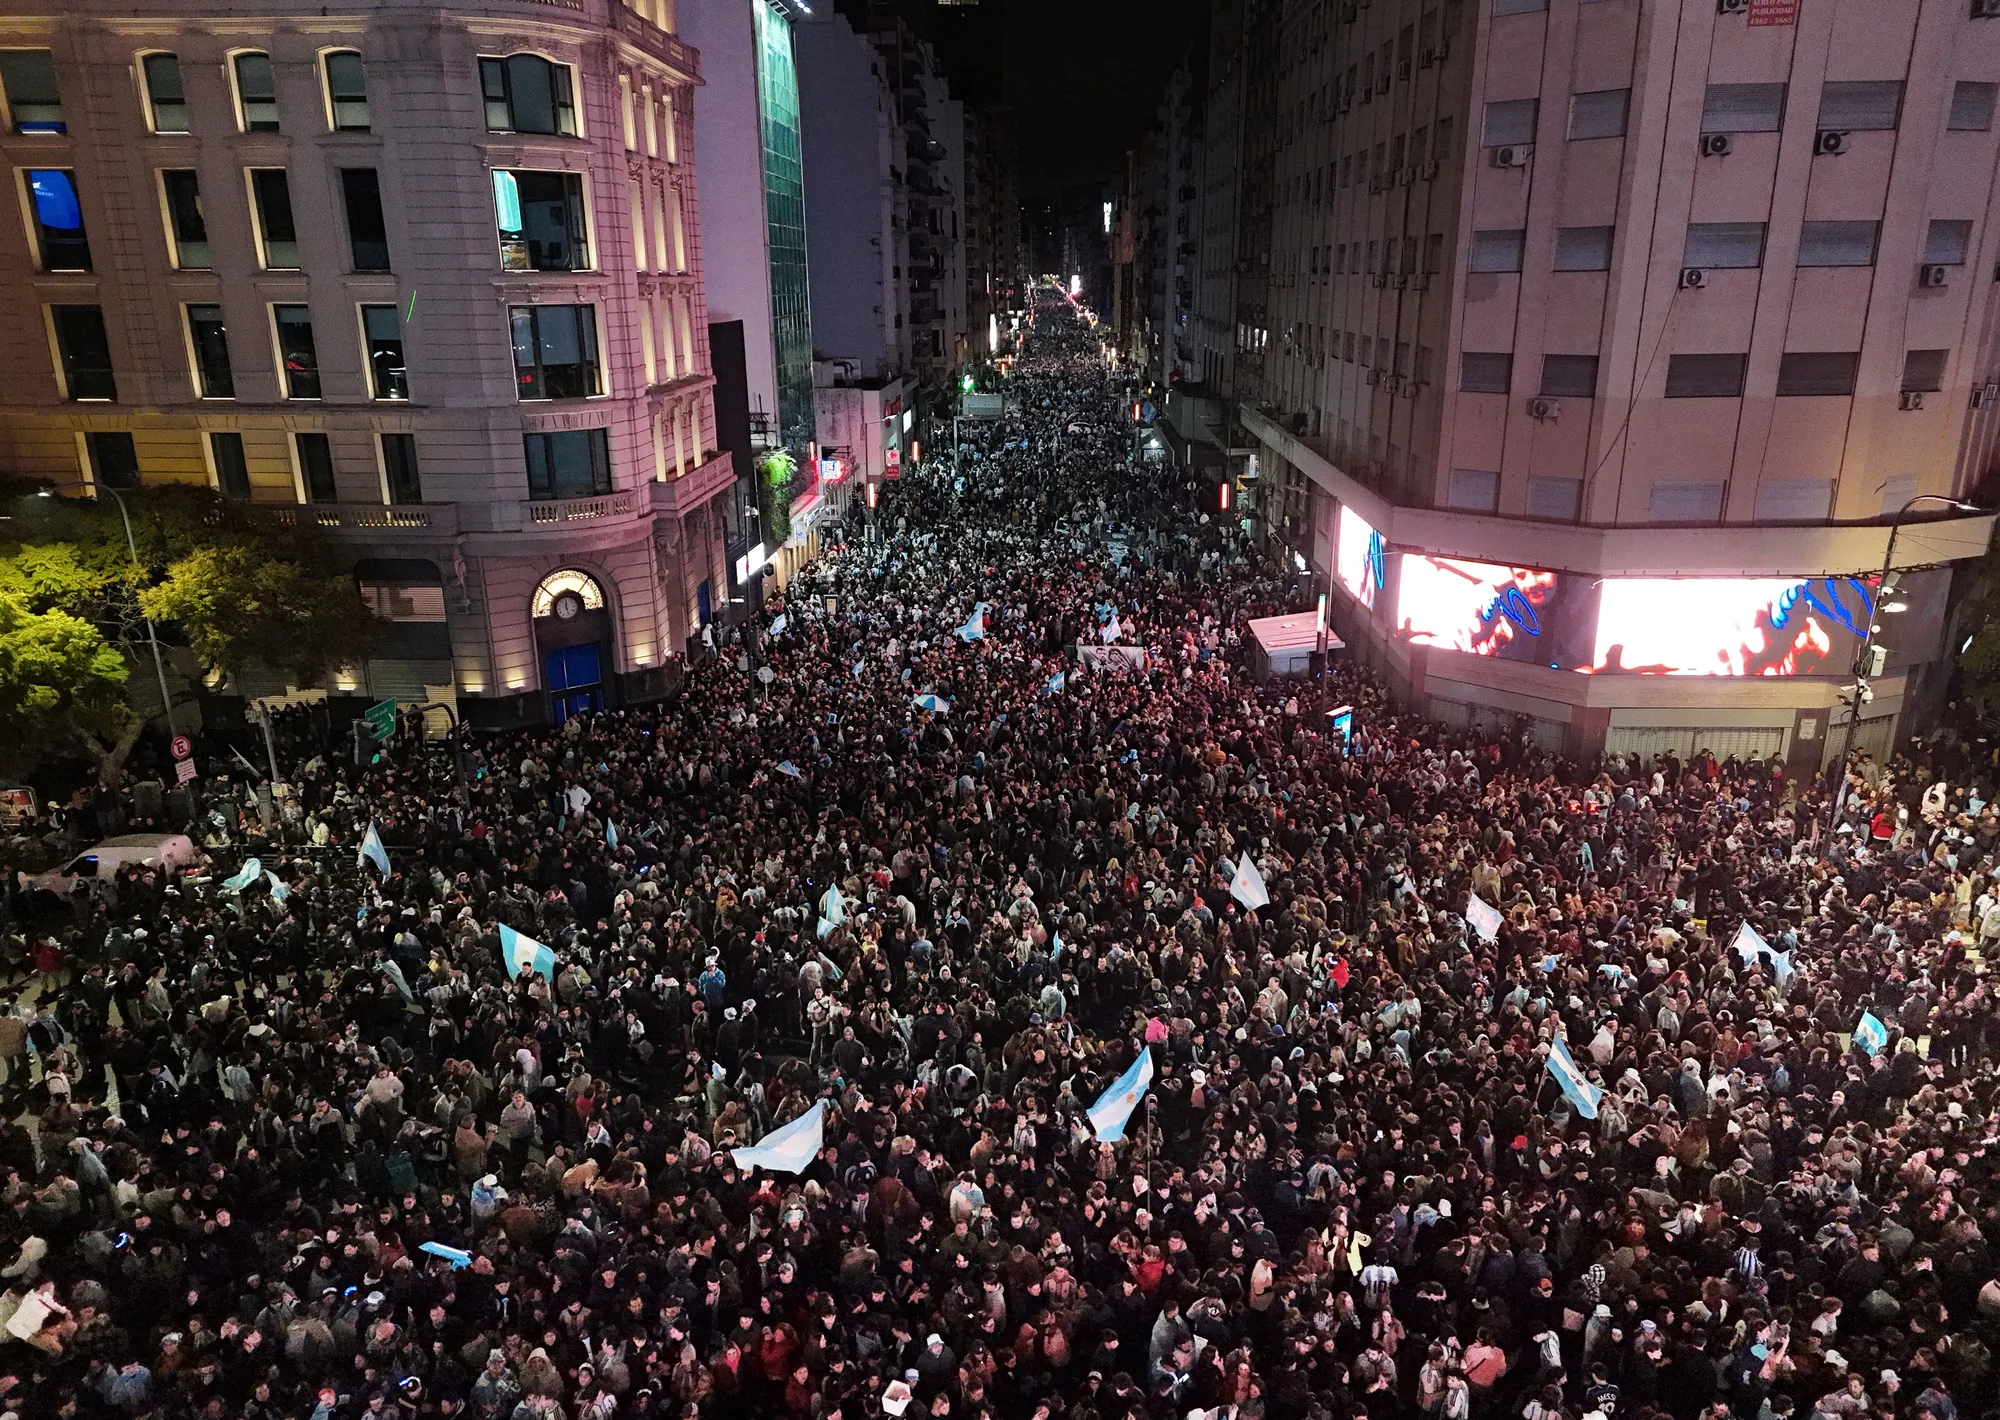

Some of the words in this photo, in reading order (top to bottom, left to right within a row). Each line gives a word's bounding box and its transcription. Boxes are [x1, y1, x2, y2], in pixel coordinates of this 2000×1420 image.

[1752, 7, 1793, 15] PUBLICIDAD
[1374, 1280, 1387, 1294] 10
[1597, 1393, 1616, 1403] MESSI
